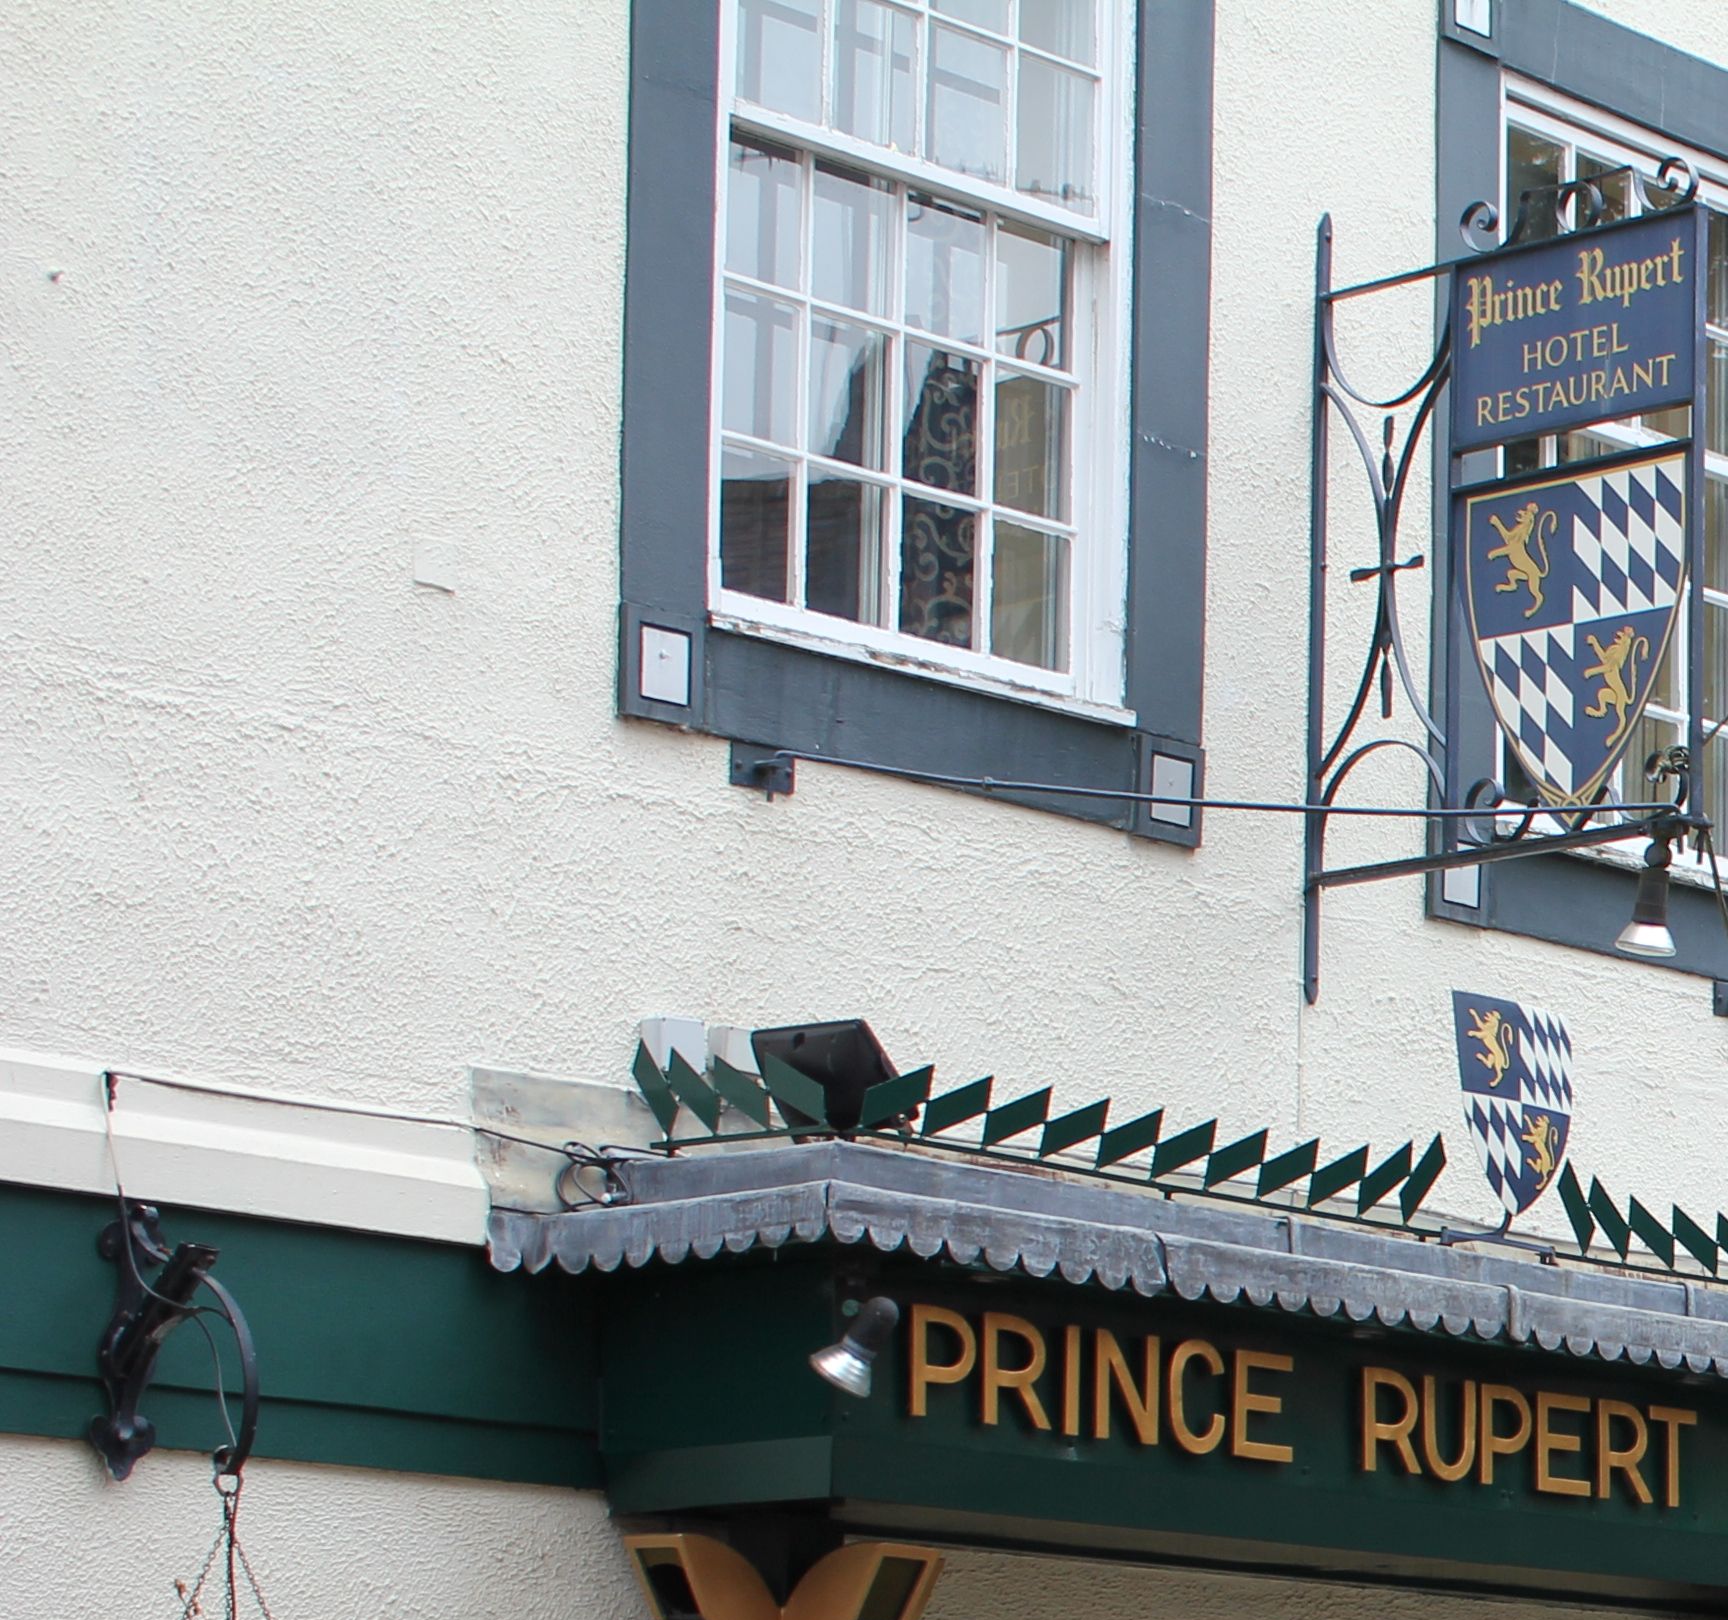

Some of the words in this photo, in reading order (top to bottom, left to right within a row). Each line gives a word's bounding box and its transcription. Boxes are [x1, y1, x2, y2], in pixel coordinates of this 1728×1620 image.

[1465, 276, 1563, 349] Prince
[1574, 237, 1685, 308] Rupert
[1476, 353, 1677, 426] RESTAURANT
[1522, 322, 1630, 373] HOTEL
[909, 1303, 1295, 1464] PRINCE
[1362, 1366, 1698, 1508] RUPERT
